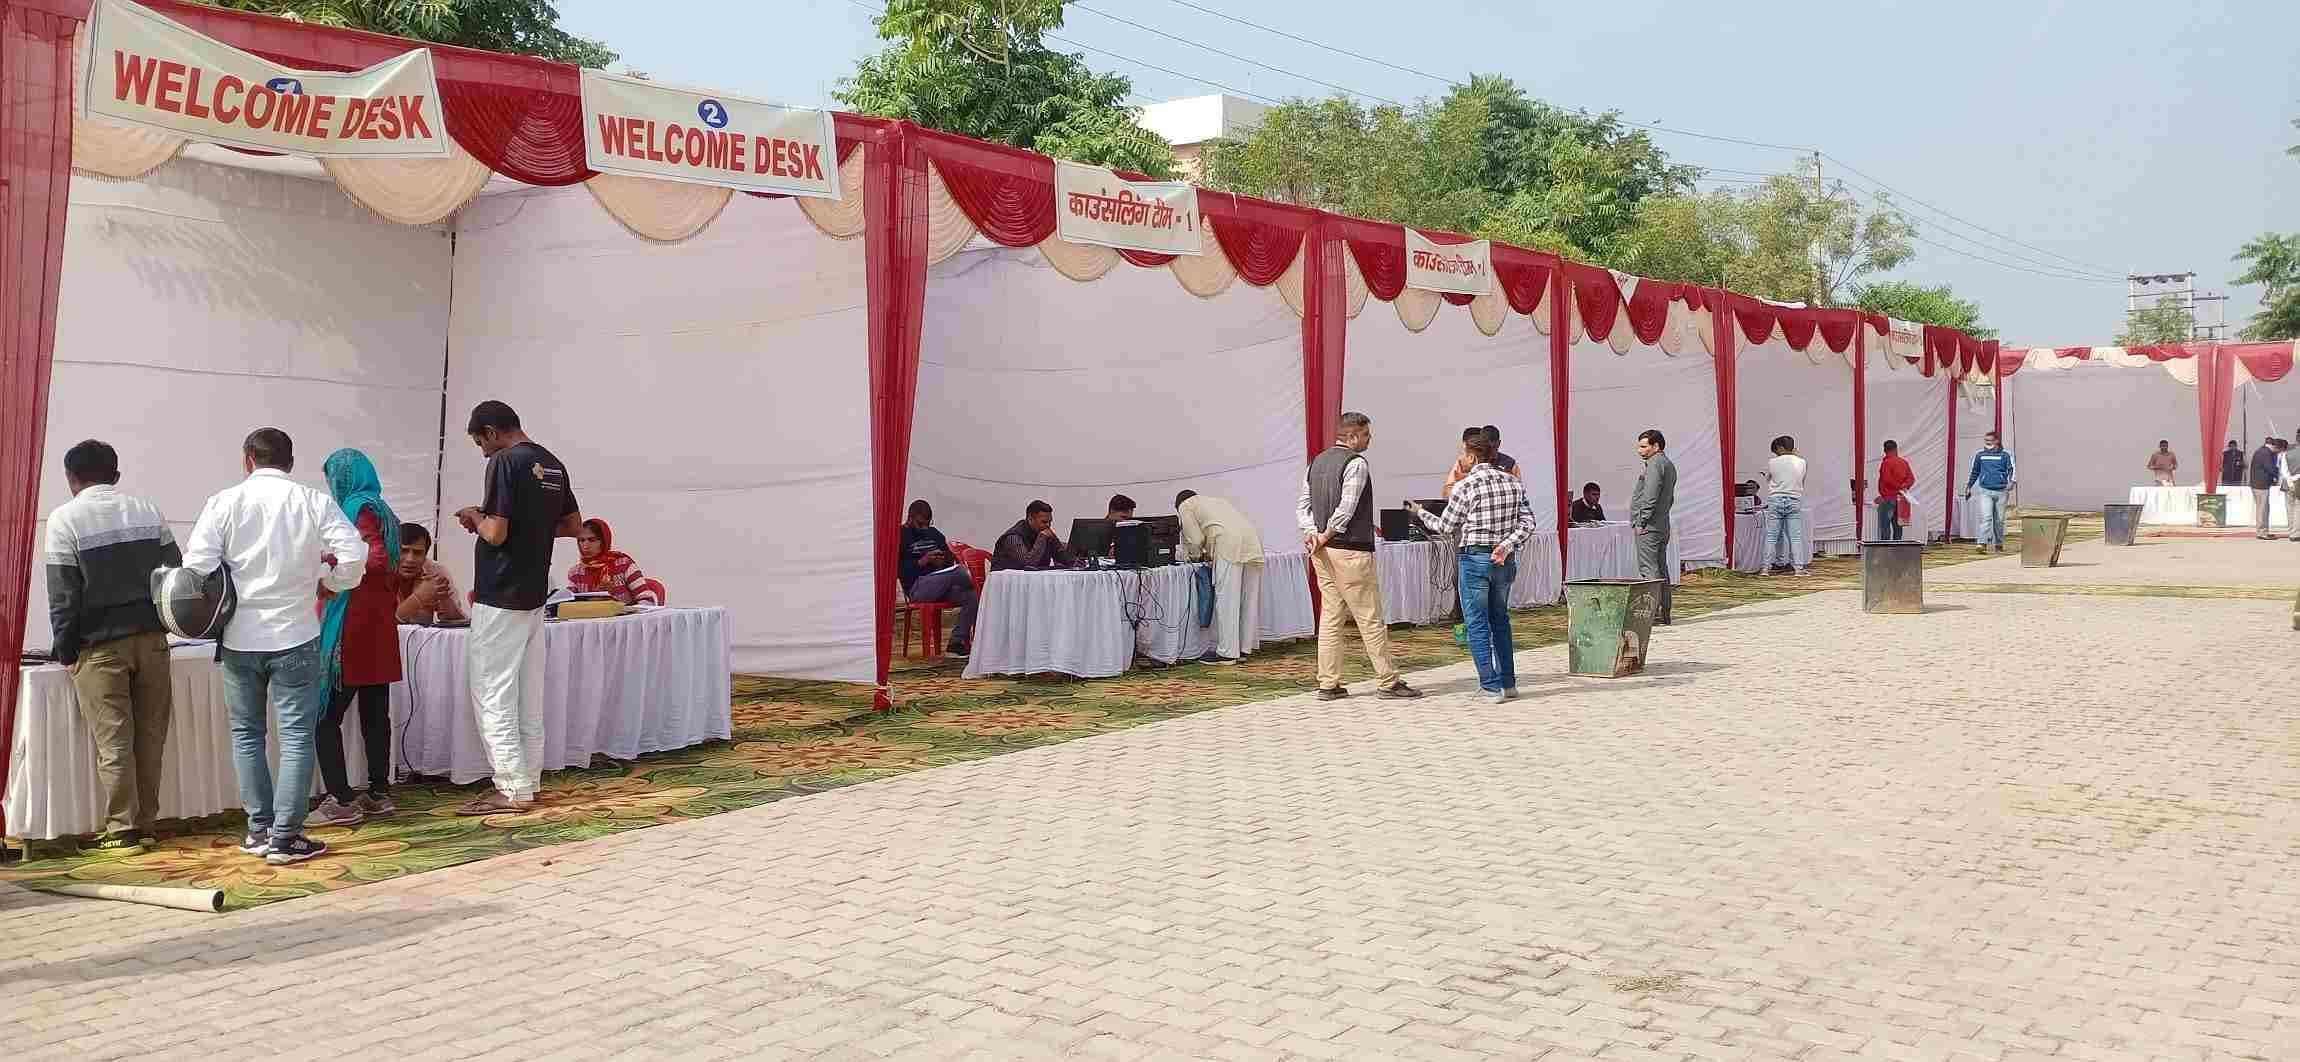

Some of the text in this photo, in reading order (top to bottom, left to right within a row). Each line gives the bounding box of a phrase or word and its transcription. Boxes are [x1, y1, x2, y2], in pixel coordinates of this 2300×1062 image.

[114, 50, 433, 140] WELCOME DESK
[703, 103, 721, 123] 2
[598, 114, 824, 180] WELCOME DESK
